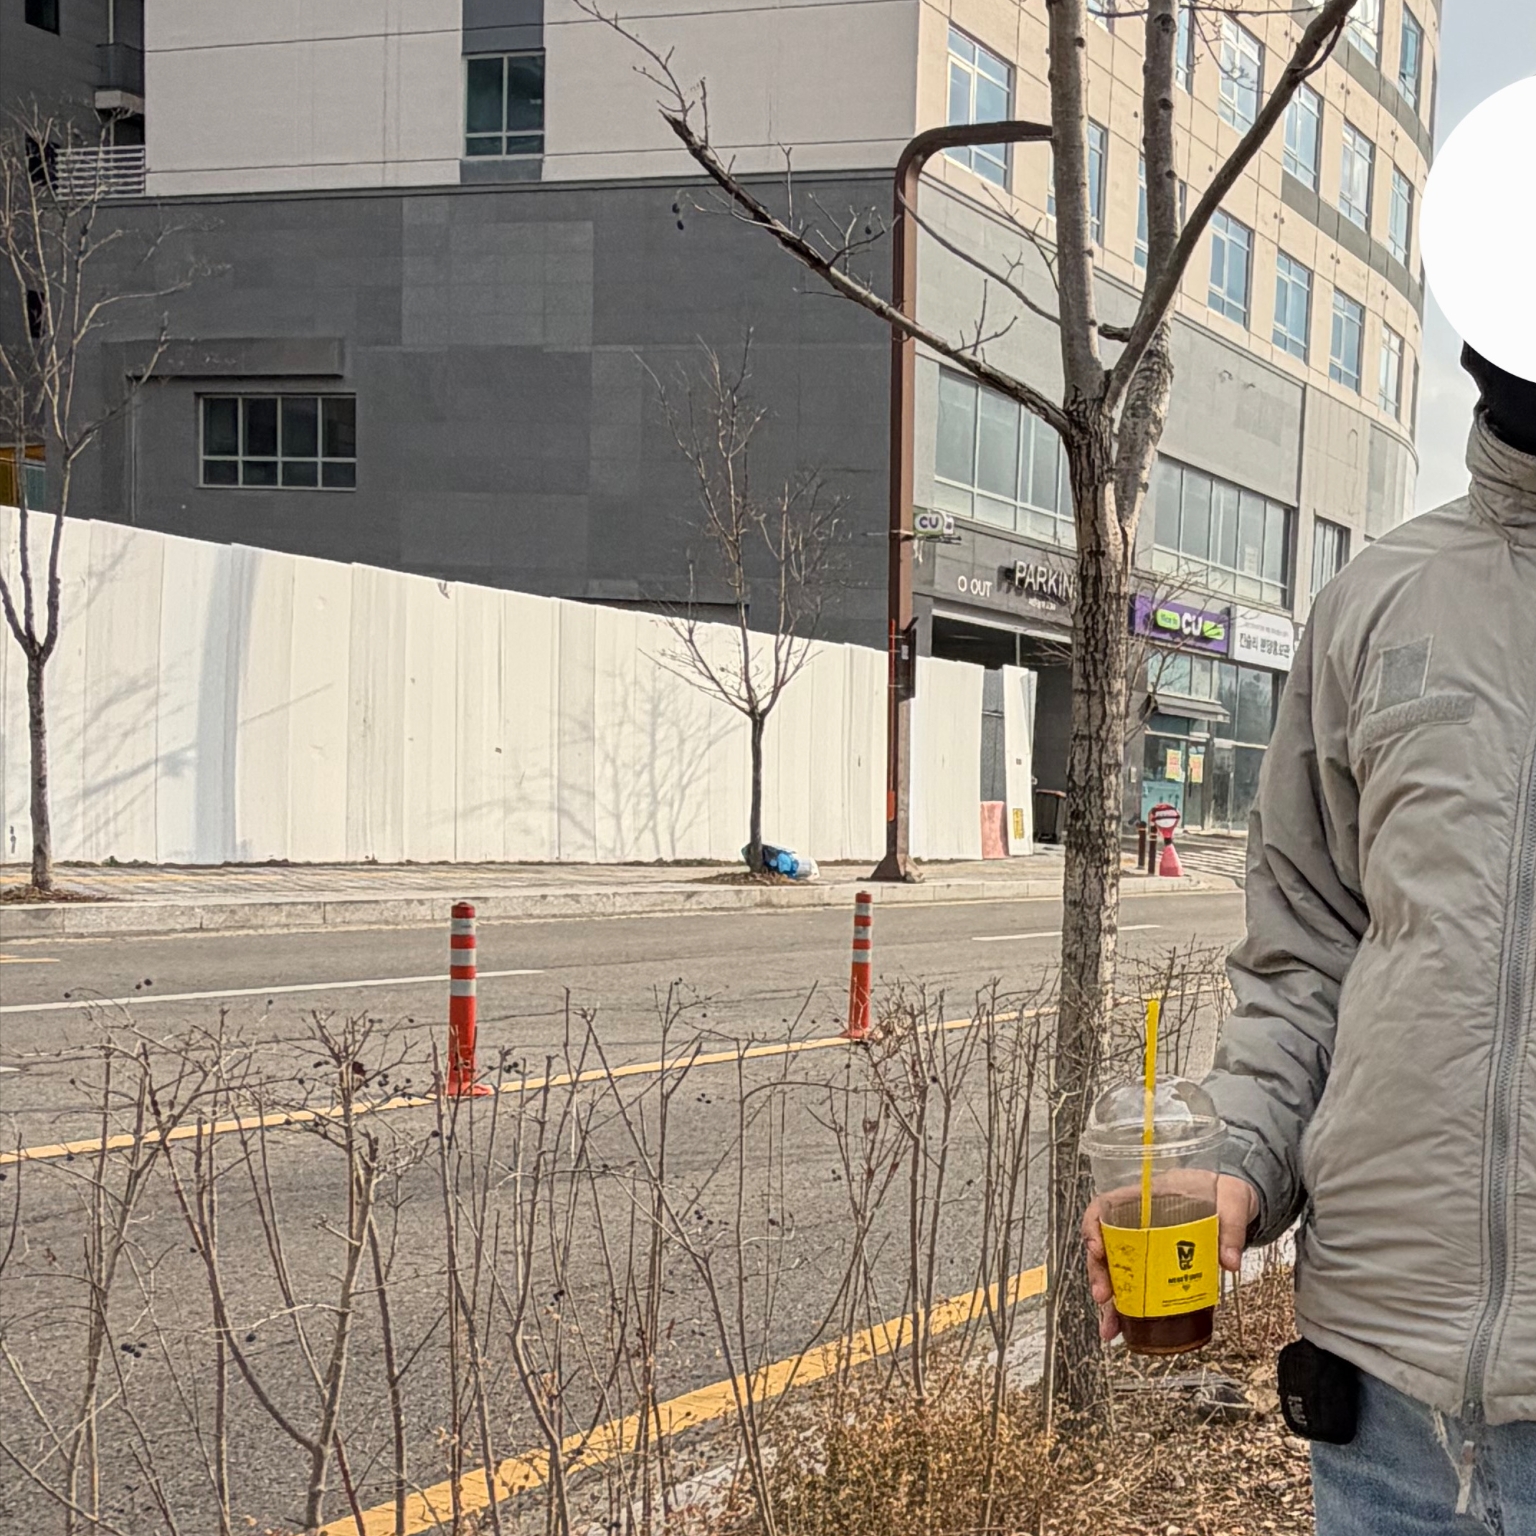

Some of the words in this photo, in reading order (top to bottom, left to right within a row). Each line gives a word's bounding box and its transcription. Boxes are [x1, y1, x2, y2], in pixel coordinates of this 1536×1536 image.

[919, 516, 939, 529] CU
[970, 578, 993, 598] OUT
[1015, 561, 1078, 600] PARKIN
[1181, 612, 1203, 636] CU
